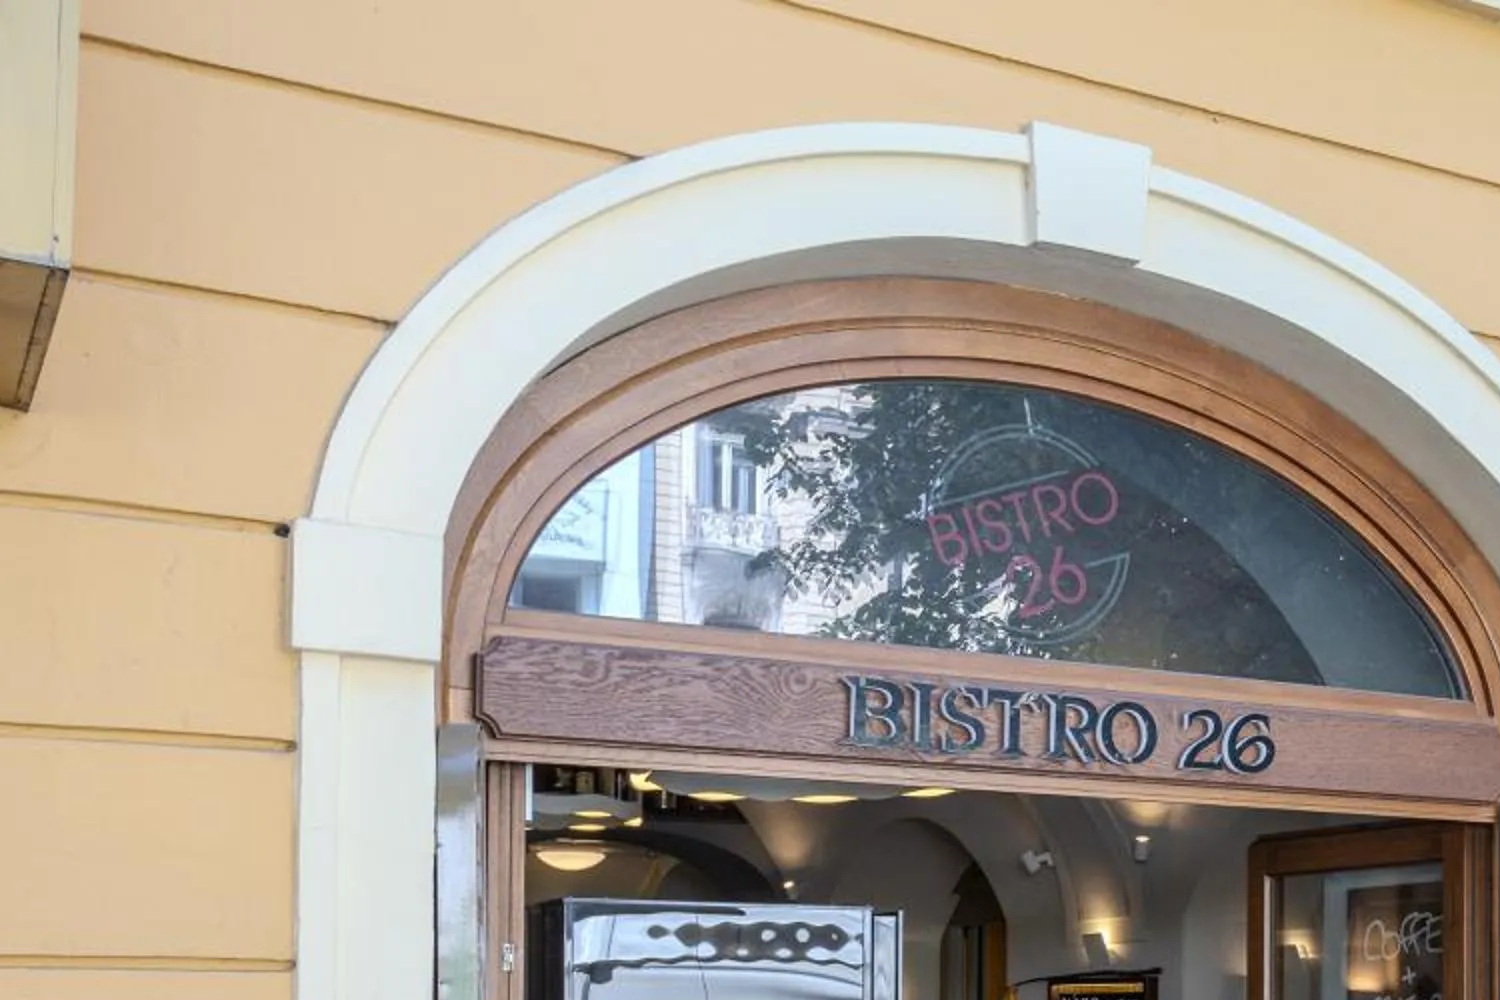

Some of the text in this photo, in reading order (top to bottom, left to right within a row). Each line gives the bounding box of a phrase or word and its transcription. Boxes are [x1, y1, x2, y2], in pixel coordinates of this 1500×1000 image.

[926, 471, 1120, 568] BISTRO
[1005, 546, 1088, 619] 26
[839, 674, 1277, 776] BISTRO 26
